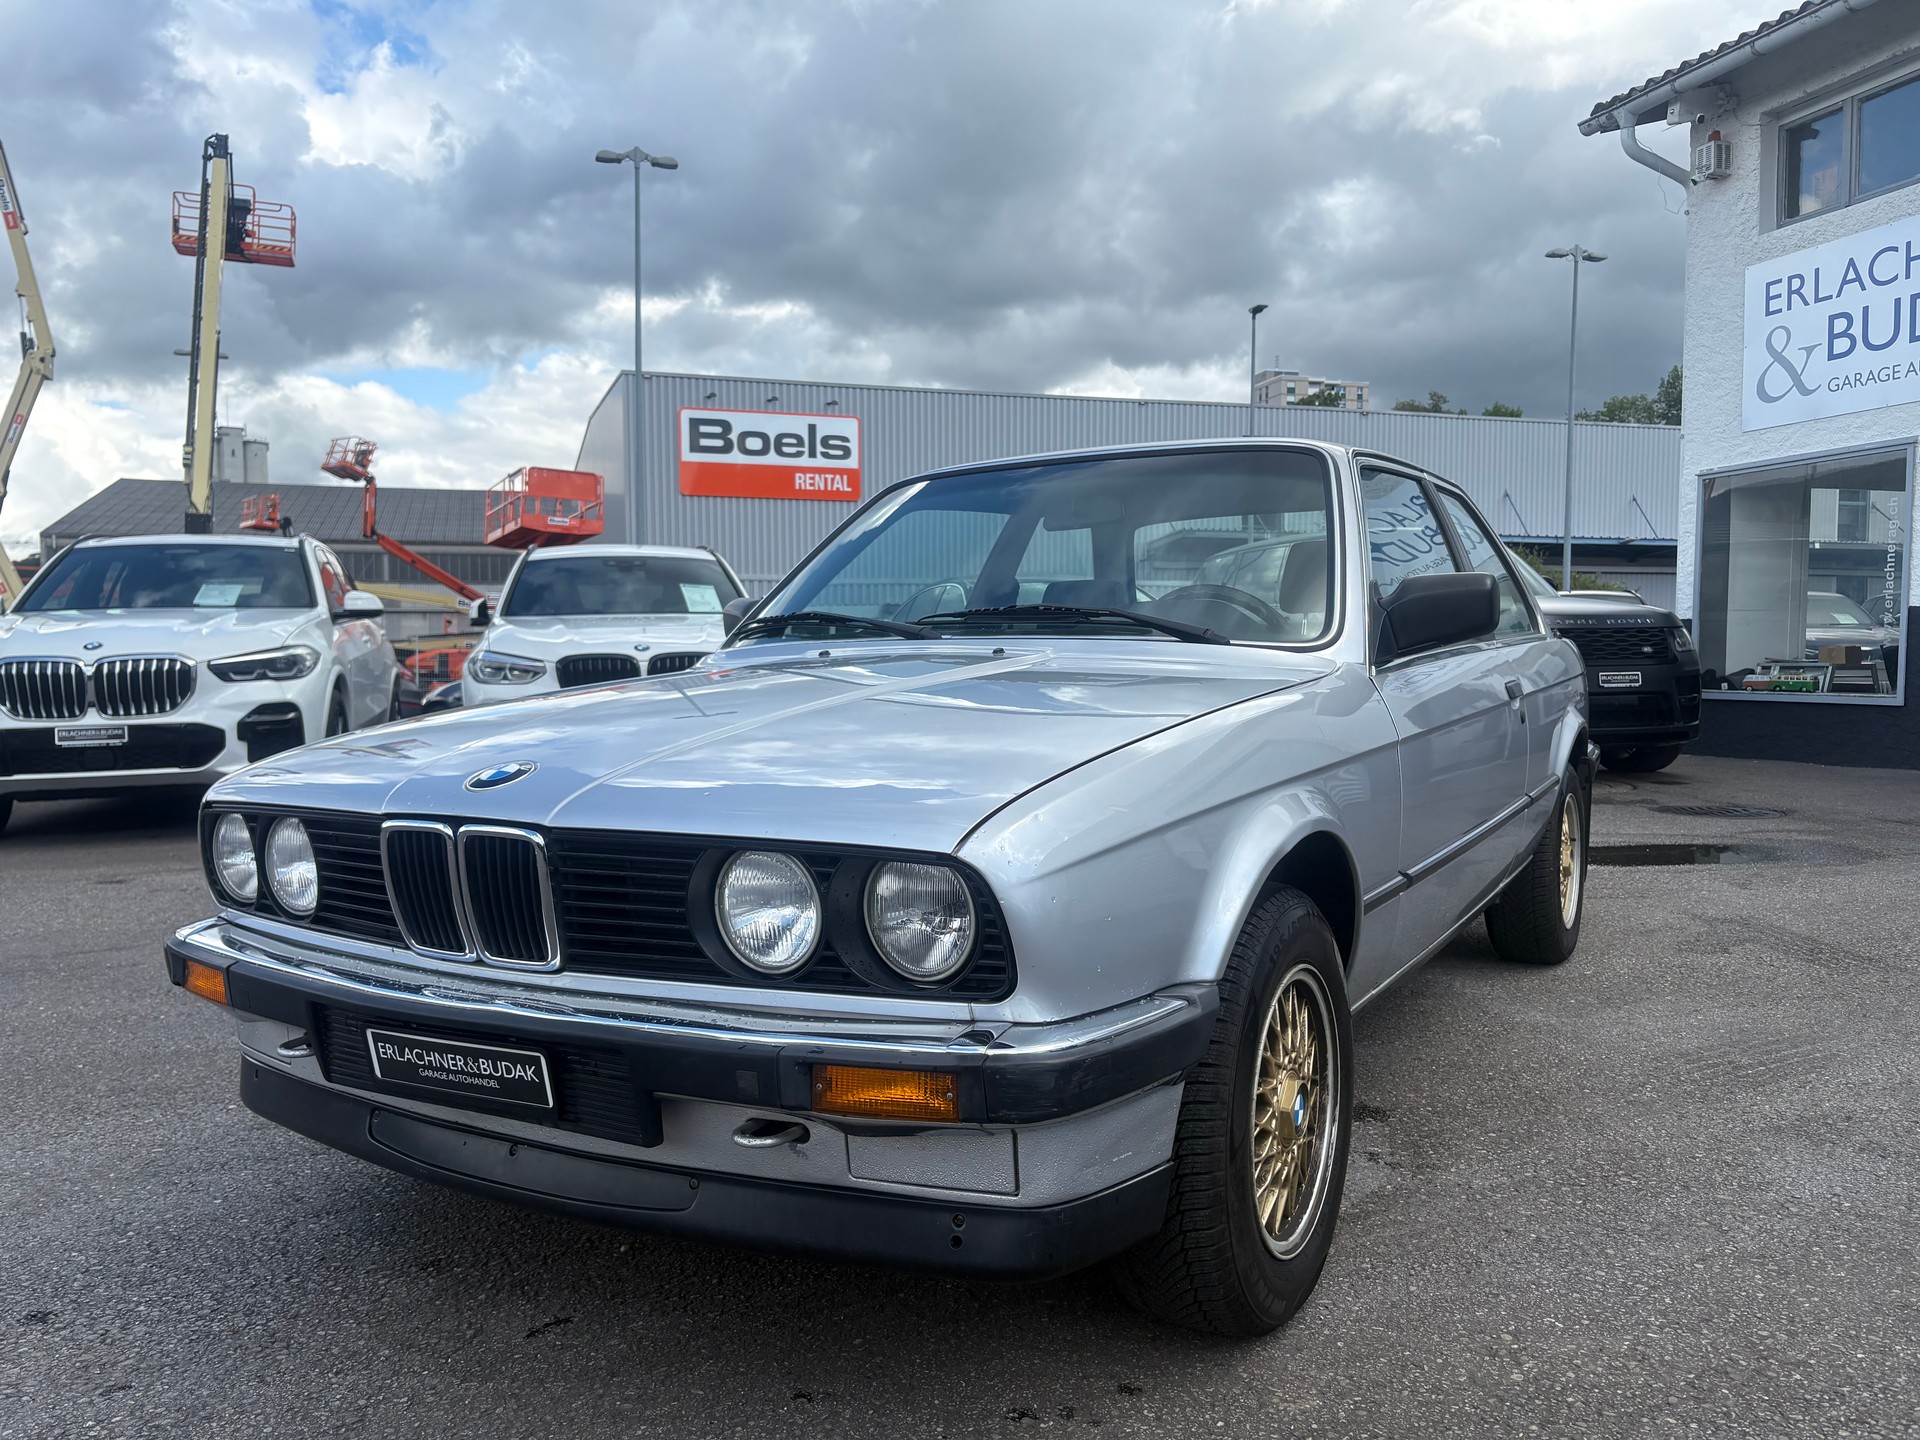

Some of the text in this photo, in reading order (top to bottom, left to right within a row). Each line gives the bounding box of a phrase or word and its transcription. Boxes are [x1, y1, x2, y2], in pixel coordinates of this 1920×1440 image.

[1827, 360, 1920, 393] GARAGE A
[689, 417, 852, 460] Boels
[795, 473, 852, 491] RENTAL
[377, 1042, 540, 1083] ERLACHNER&BUDAK
[418, 1067, 501, 1088] GARAGE AUTOHANDEL
